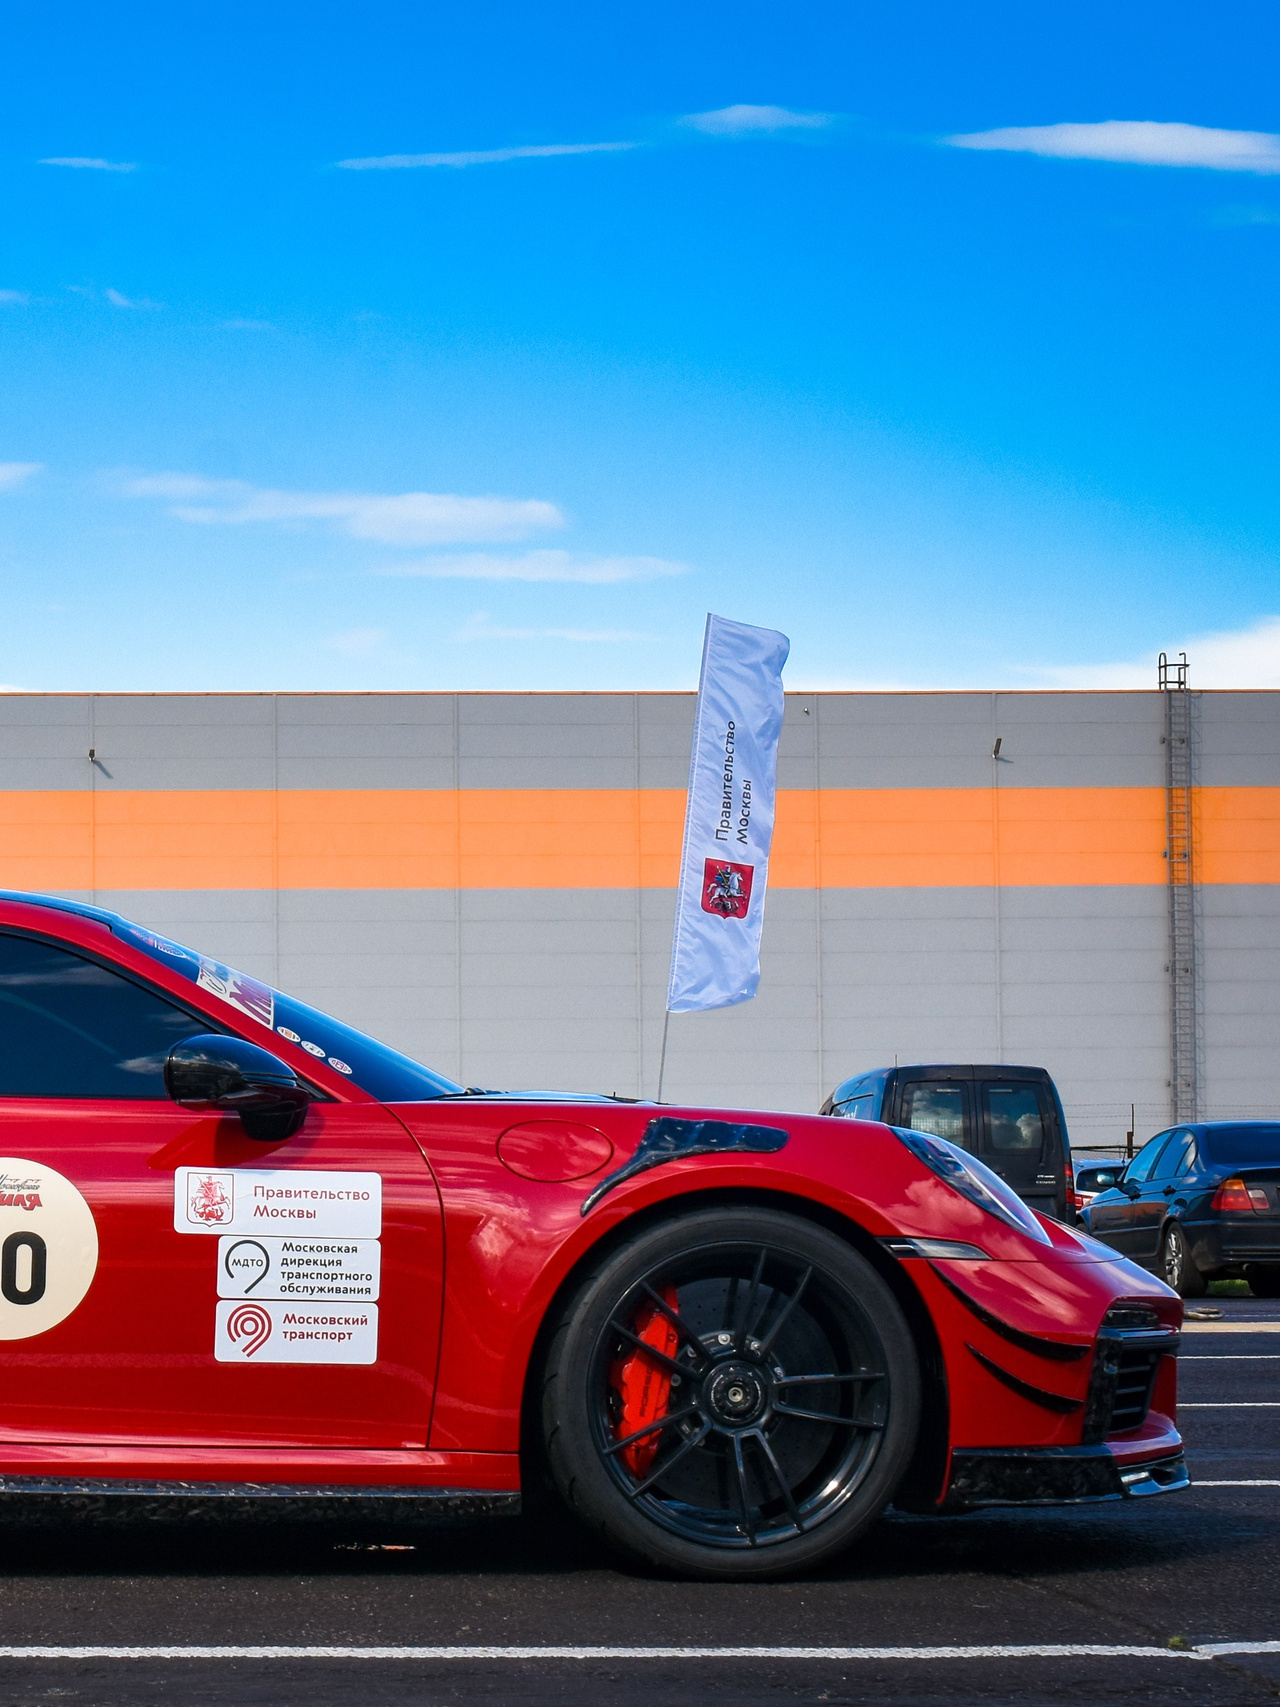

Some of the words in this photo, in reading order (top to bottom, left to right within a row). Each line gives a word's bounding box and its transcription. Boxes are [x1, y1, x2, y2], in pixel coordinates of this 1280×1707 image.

[715, 720, 736, 842] Правительство
[736, 779, 752, 845] Москвы
[253, 1185, 370, 1201] Правительство
[253, 1205, 317, 1219] Москвы
[281, 1242, 358, 1254] Московская
[231, 1258, 264, 1268] МДТО
[280, 1257, 342, 1268] дирекция
[280, 1271, 373, 1282] транспортного
[279, 1283, 372, 1295] обслуживания
[282, 1313, 368, 1326] Московский
[282, 1330, 353, 1343] транспорт
